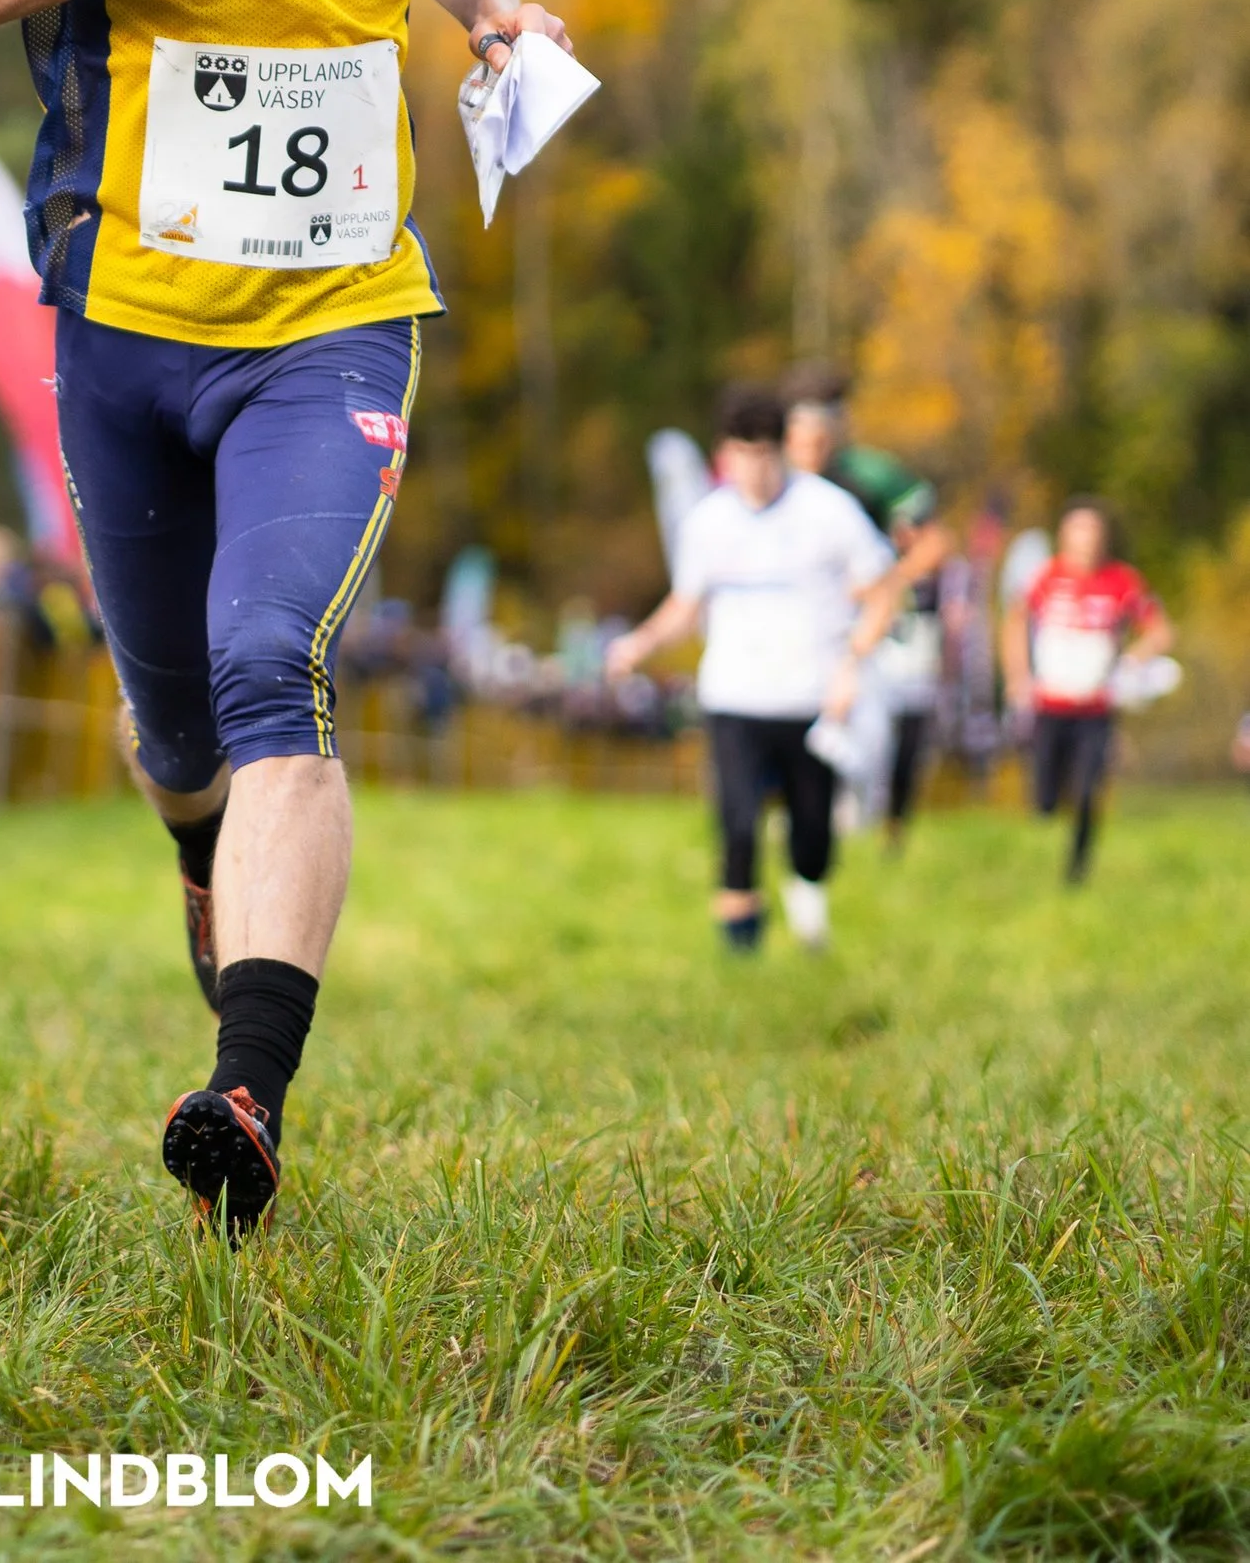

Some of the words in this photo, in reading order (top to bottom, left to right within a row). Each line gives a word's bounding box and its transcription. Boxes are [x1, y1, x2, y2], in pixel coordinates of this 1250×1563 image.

[258, 59, 363, 83] UPPLANDS
[258, 85, 326, 109] VÄSBY
[223, 124, 329, 198] 18
[352, 164, 369, 191] 1
[335, 210, 391, 226] UPPLANDS
